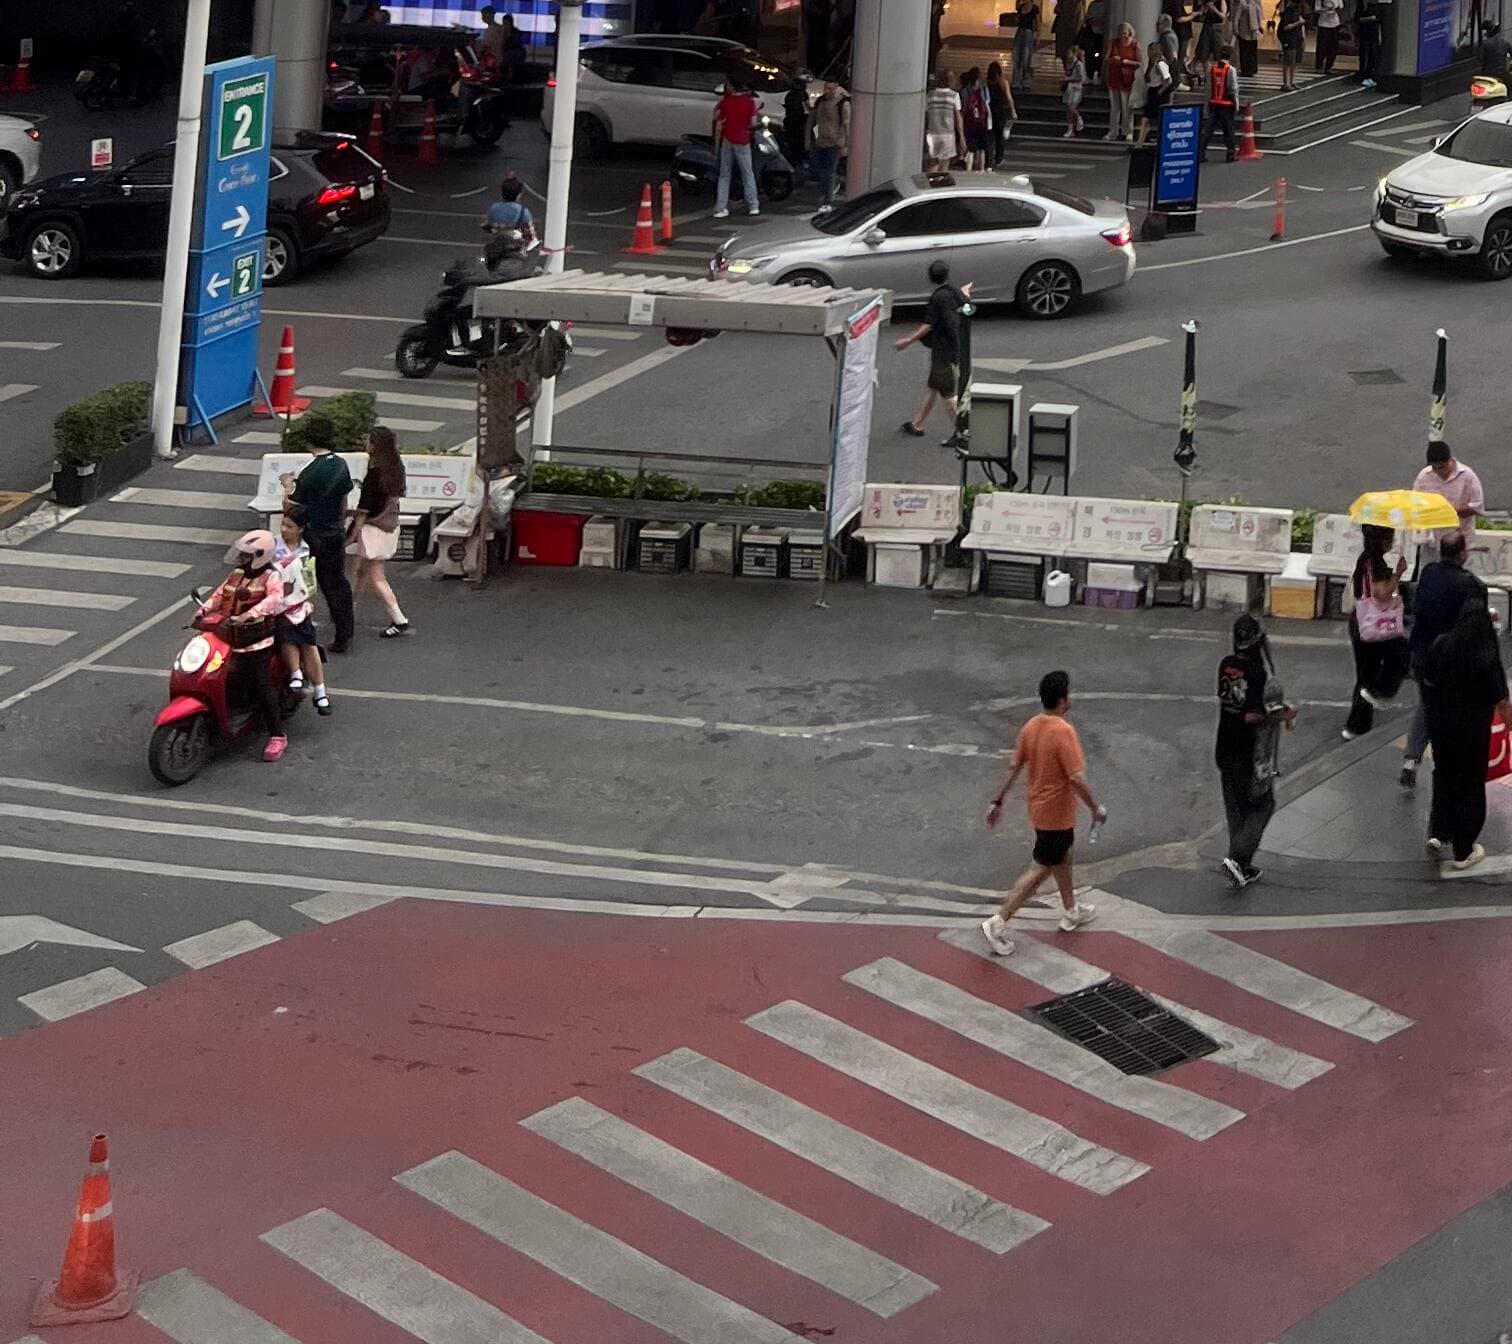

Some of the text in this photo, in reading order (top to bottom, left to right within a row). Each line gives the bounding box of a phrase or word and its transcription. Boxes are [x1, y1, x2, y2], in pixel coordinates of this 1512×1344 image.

[224, 82, 266, 103] ENTRANCE
[231, 103, 253, 151] 2
[236, 256, 255, 270] EXIT
[238, 269, 251, 294] 2
